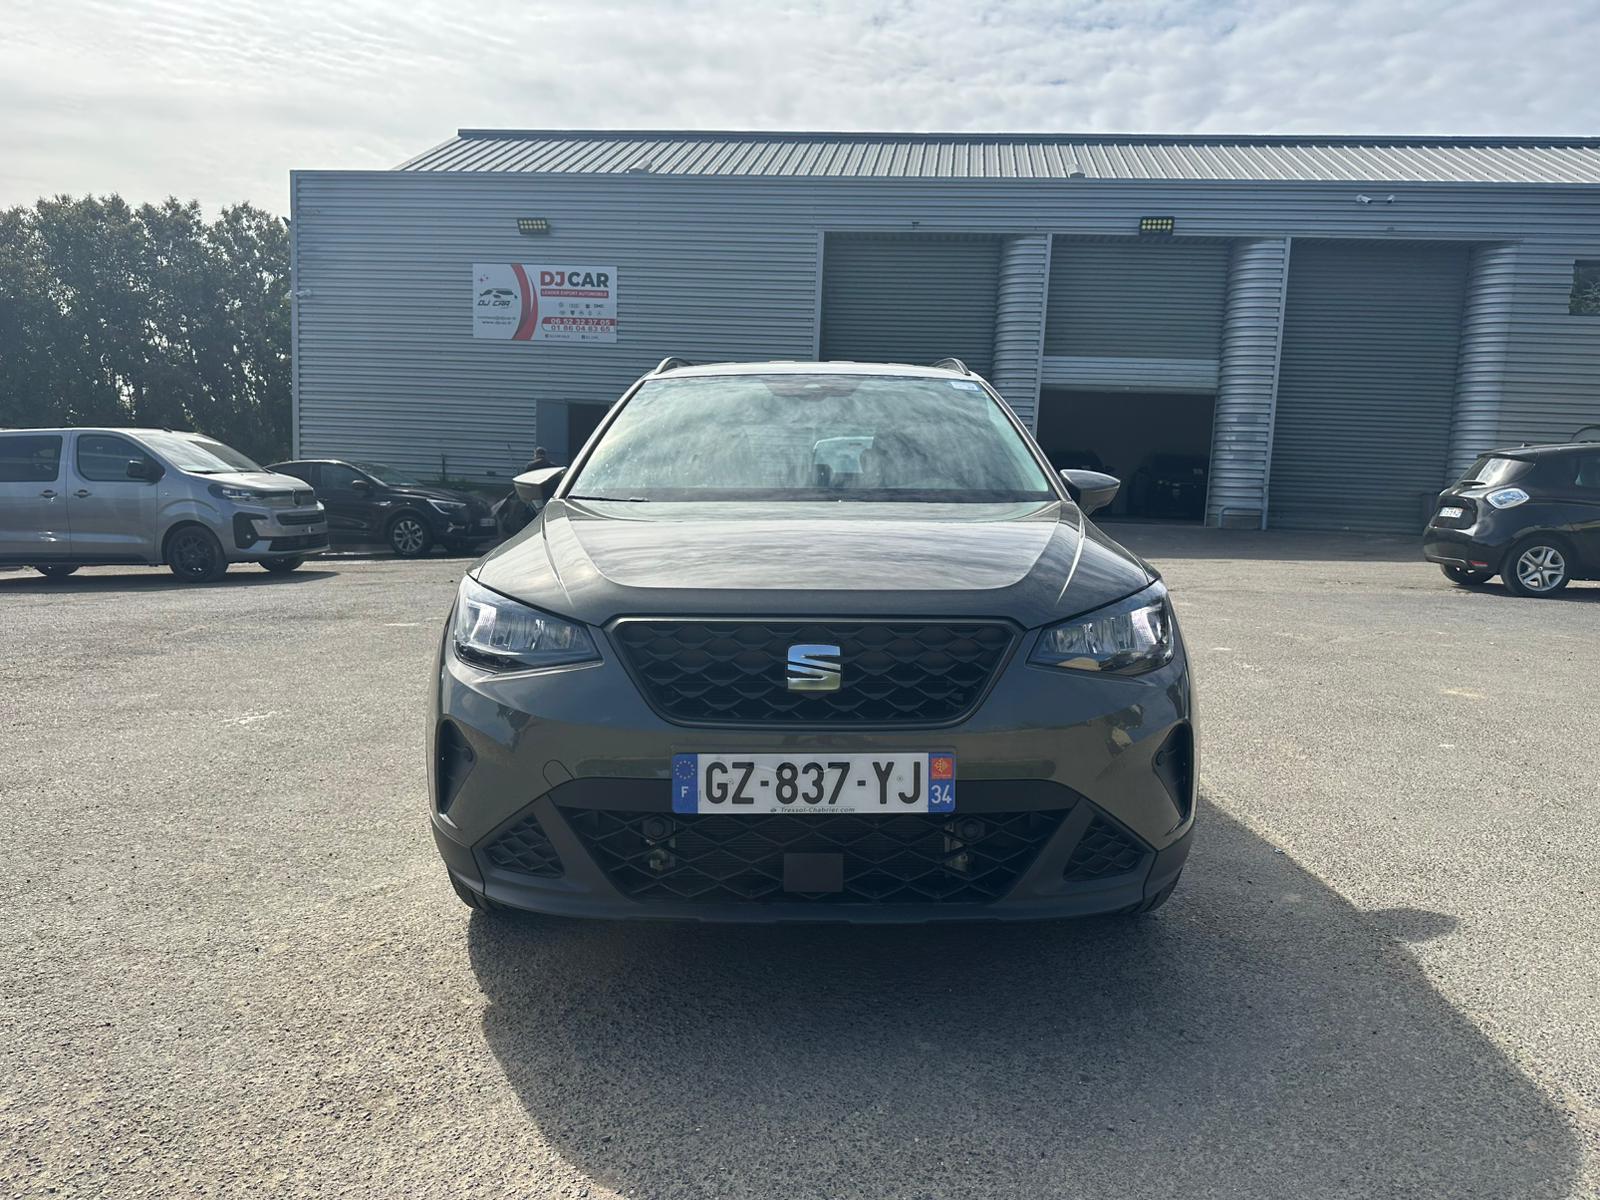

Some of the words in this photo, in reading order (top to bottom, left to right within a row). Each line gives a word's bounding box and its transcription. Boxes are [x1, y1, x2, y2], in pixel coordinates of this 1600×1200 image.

[540, 271, 565, 287] DJ
[567, 271, 609, 288] CAR
[680, 786, 689, 798] F
[705, 761, 922, 806] GZ-837-YJ
[930, 784, 952, 804] 34
